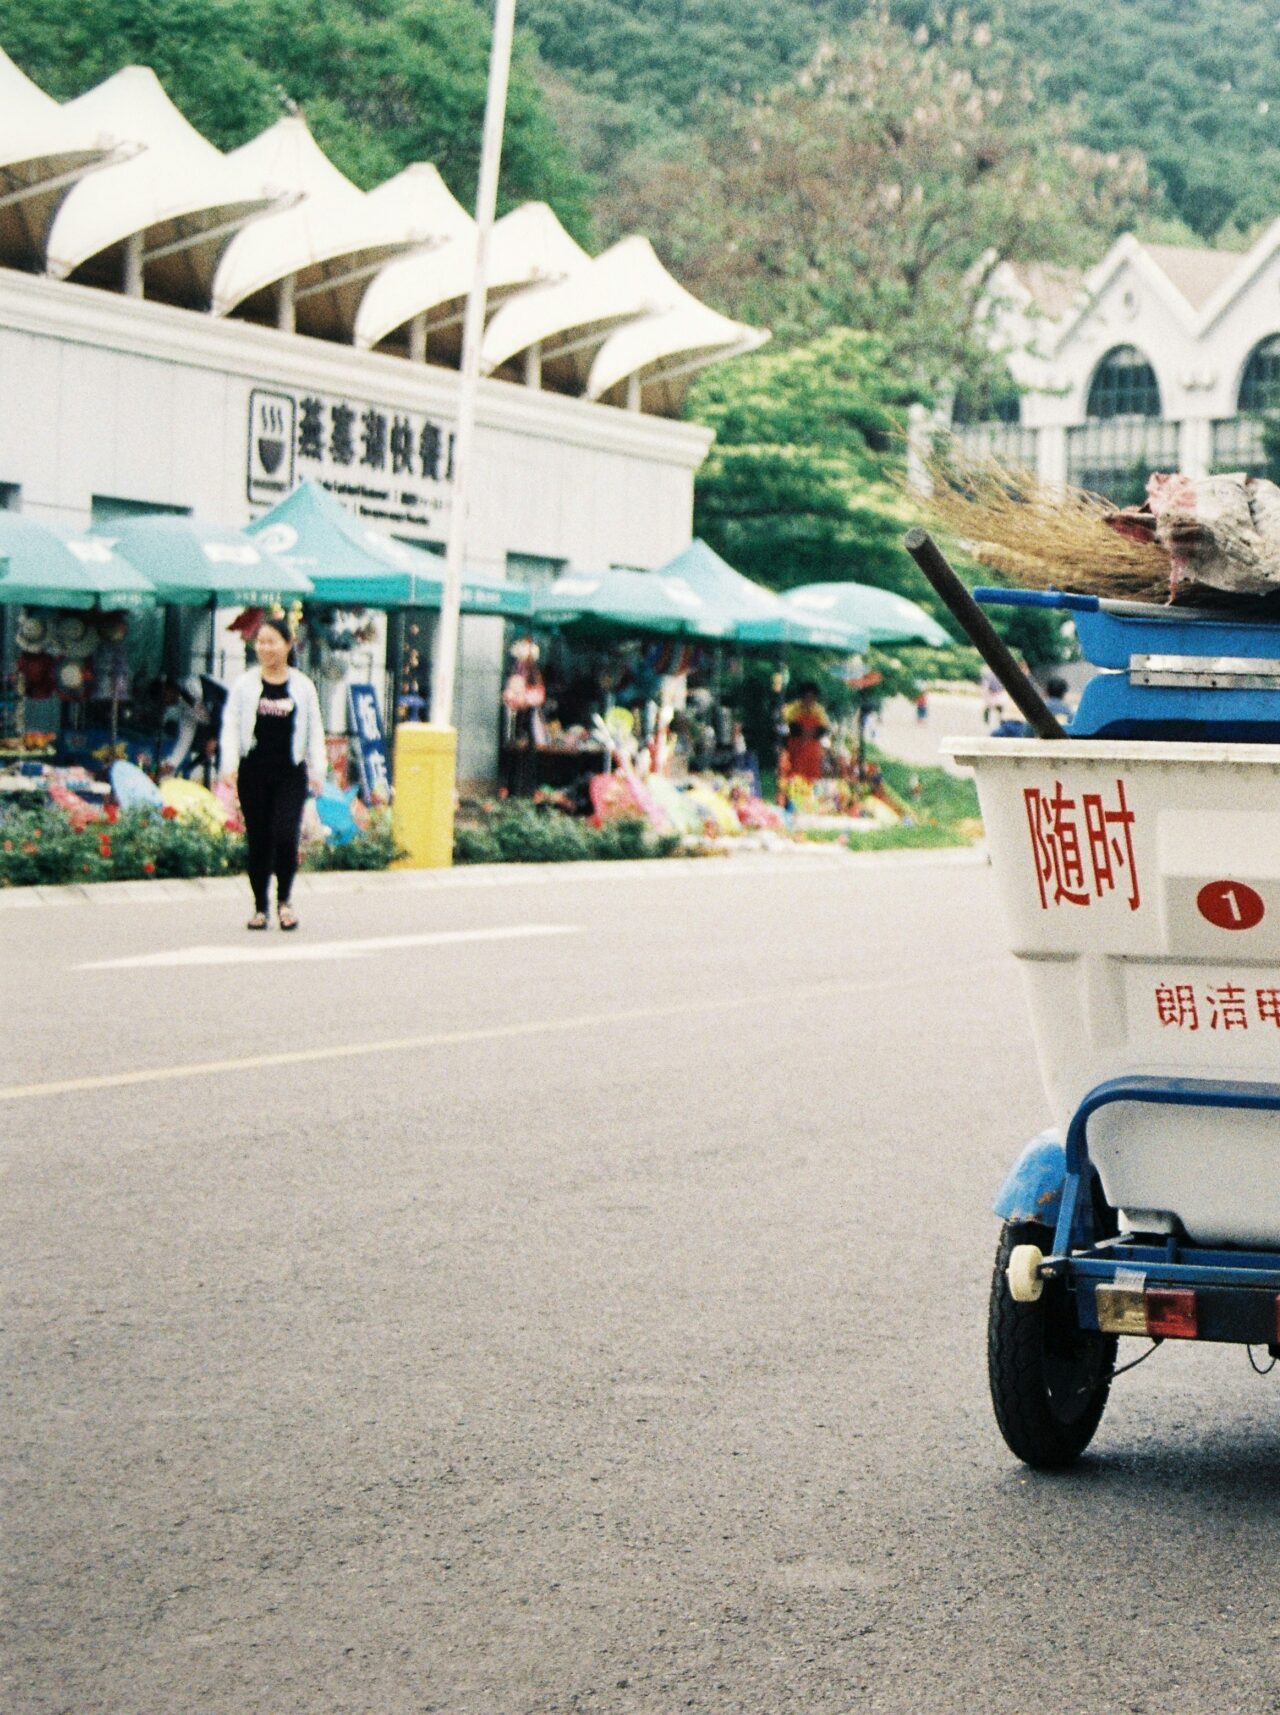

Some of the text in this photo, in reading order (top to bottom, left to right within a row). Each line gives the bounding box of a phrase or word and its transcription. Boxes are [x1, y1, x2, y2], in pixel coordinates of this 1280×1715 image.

[298, 396, 457, 482] 燕塞湖快餐
[1023, 779, 1141, 911] 随时
